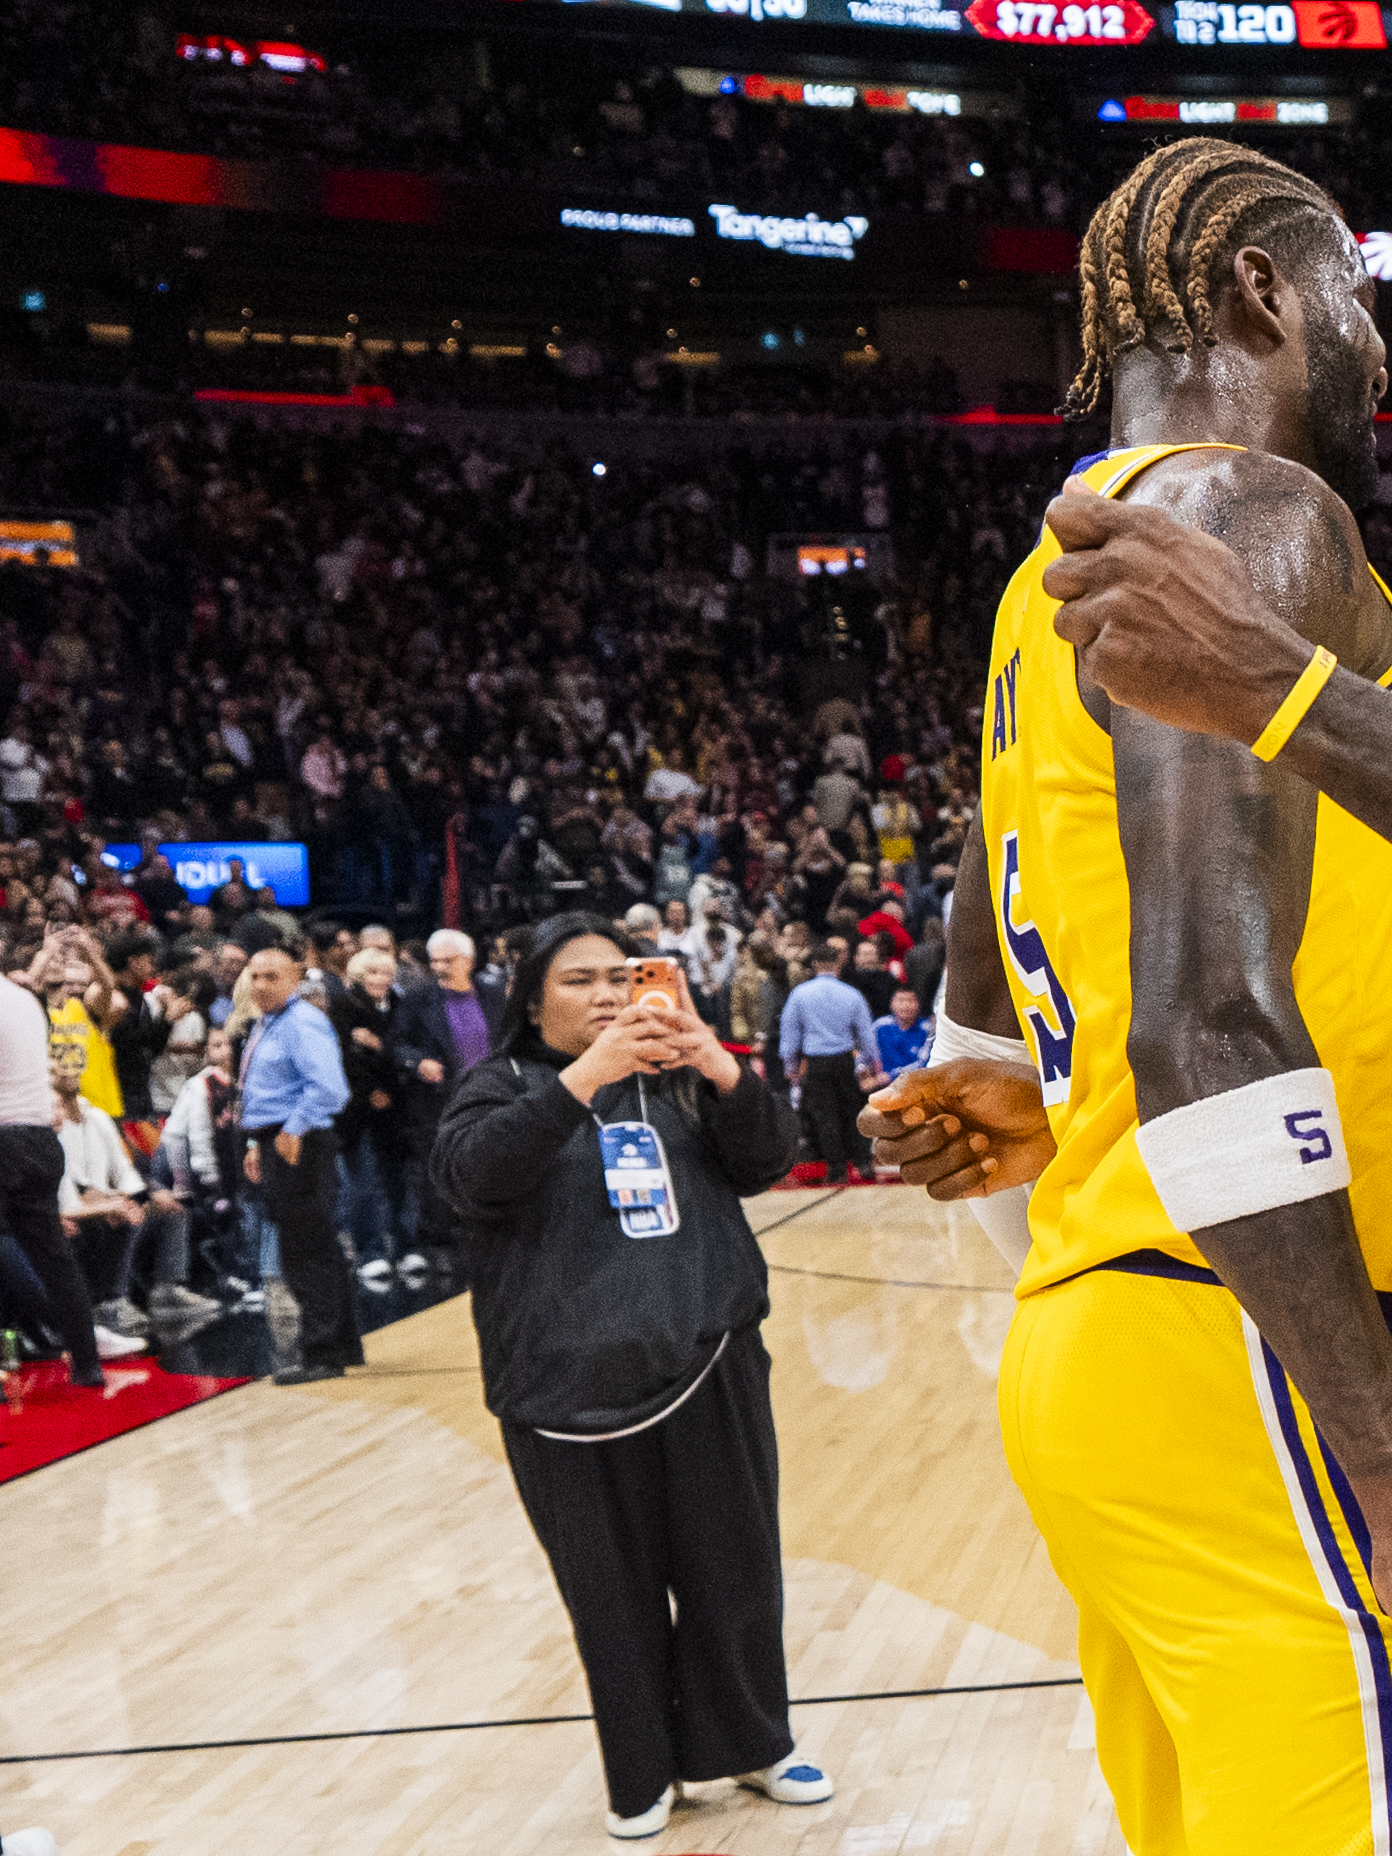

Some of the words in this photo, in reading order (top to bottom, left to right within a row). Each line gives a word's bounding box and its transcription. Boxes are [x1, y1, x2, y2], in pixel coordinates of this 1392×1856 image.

[996, 1, 1125, 42] $77,912
[1217, 5, 1296, 43] 120
[708, 204, 853, 248] Tangerine
[991, 647, 1020, 761] AY
[1001, 828, 1076, 1107] 5
